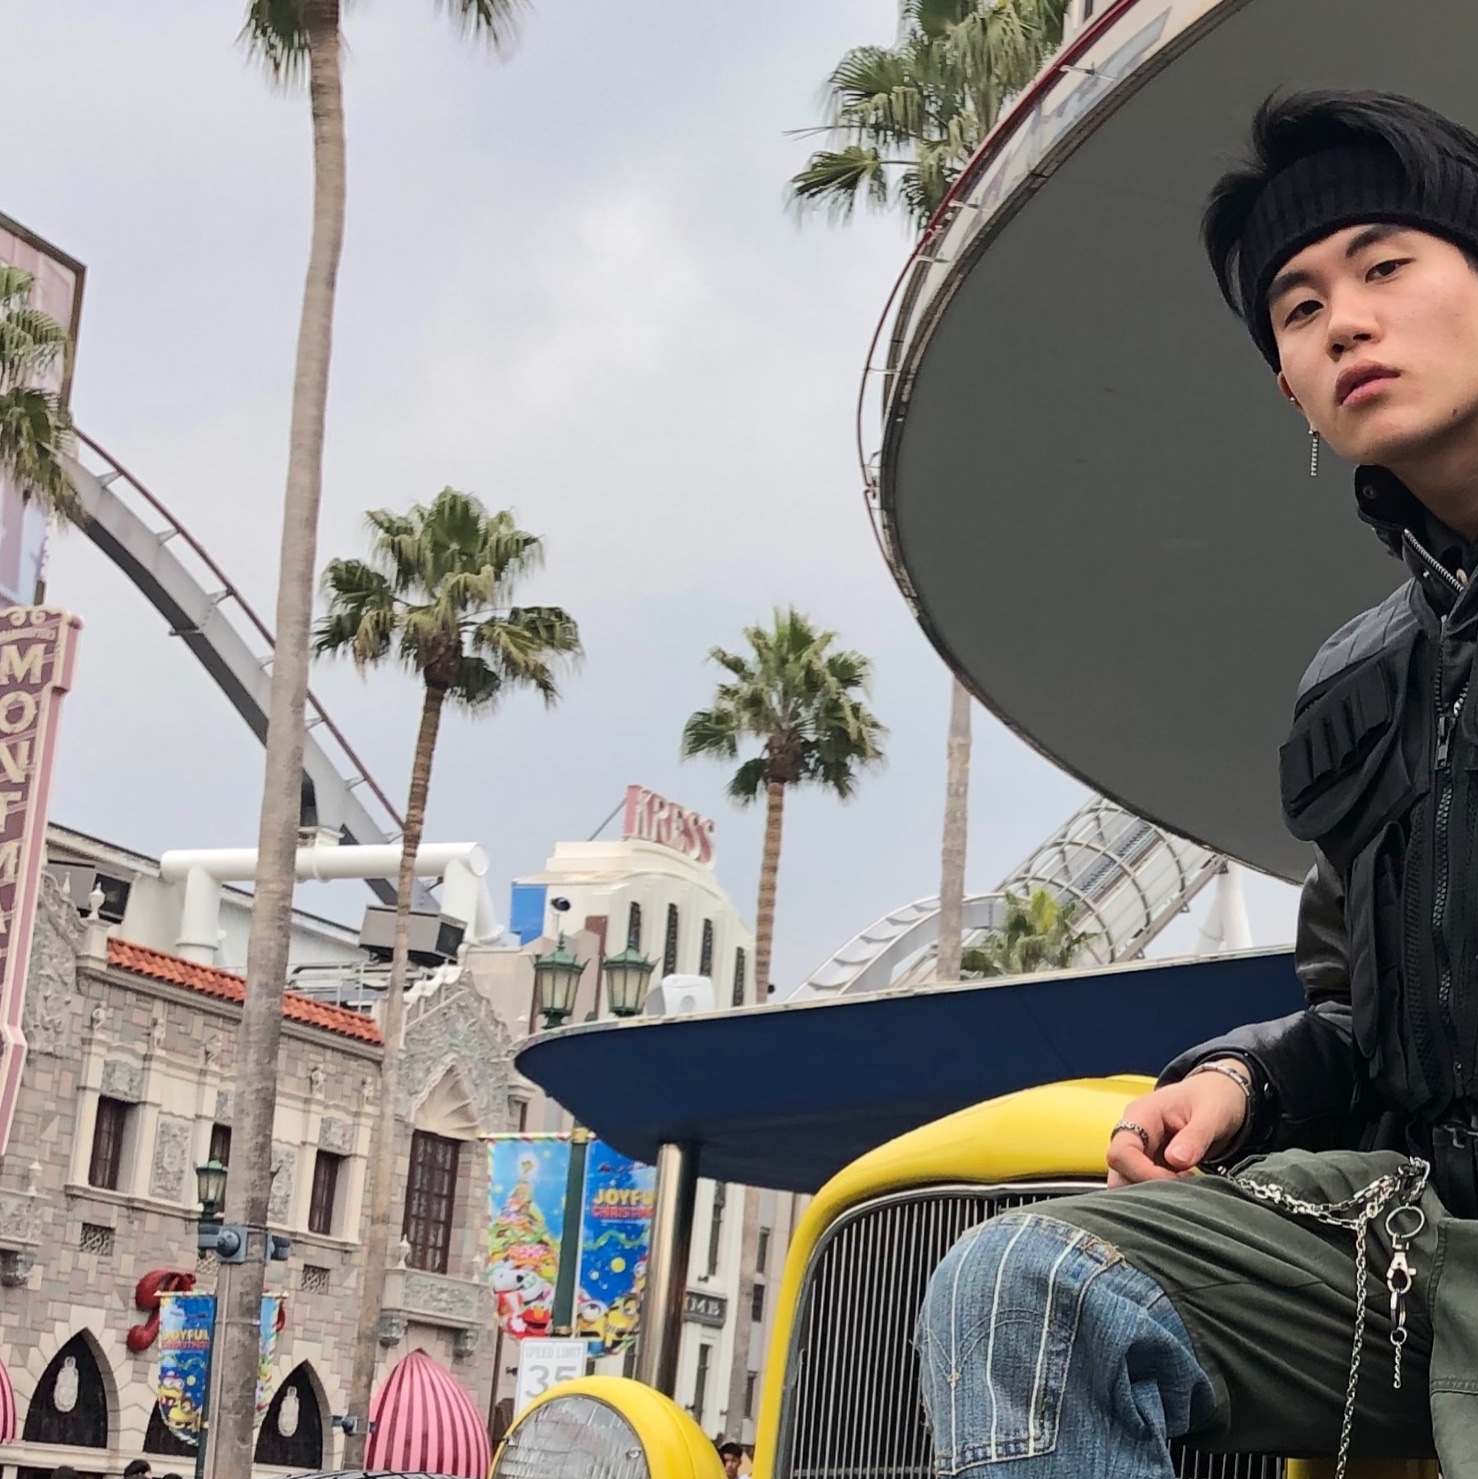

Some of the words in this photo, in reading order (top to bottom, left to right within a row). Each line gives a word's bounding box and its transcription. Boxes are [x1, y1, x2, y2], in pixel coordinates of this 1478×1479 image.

[623, 784, 715, 870] KRESS
[593, 1187, 657, 1206] JOYFU
[525, 1345, 555, 1359] SPEED
[555, 1345, 582, 1359] LIMIT
